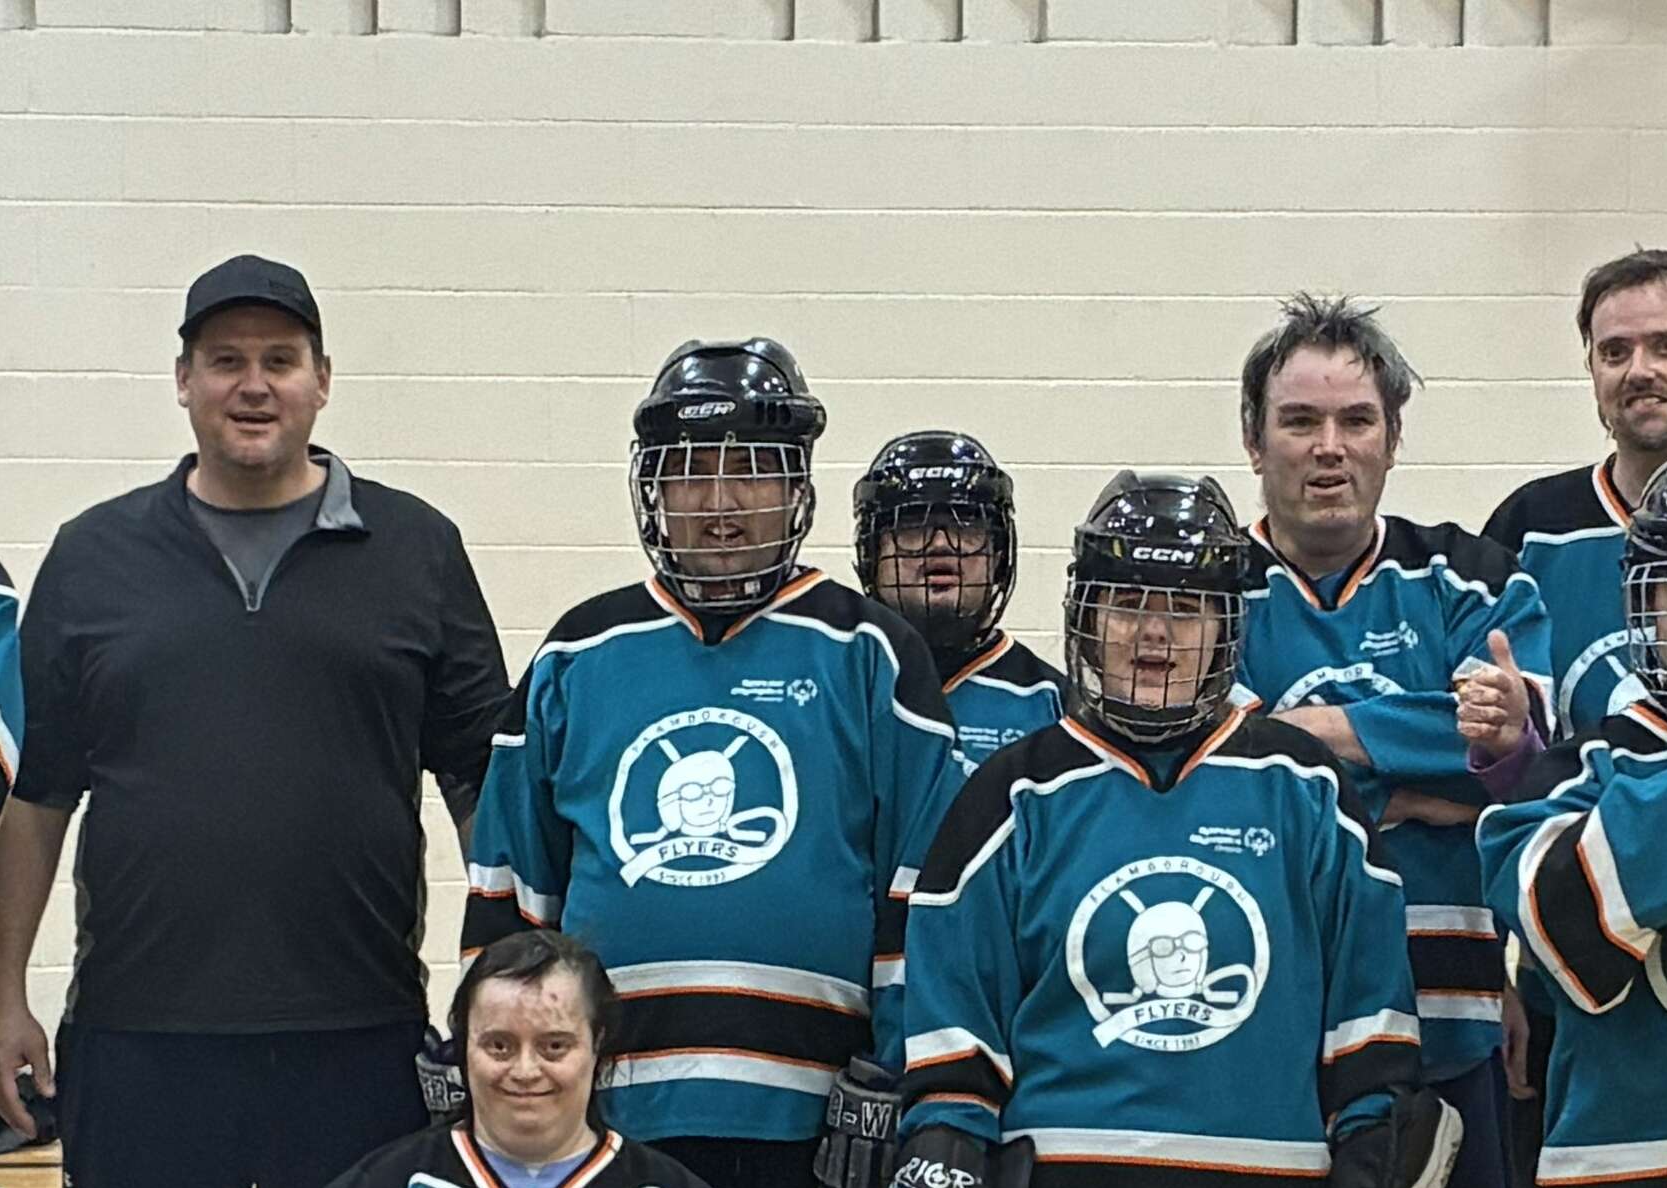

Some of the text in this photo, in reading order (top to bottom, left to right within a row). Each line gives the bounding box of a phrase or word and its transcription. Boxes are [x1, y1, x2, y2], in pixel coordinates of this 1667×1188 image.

[1133, 547, 1195, 563] CCM
[658, 842, 739, 860] FLYERS
[1133, 1002, 1214, 1023] FLYERS
